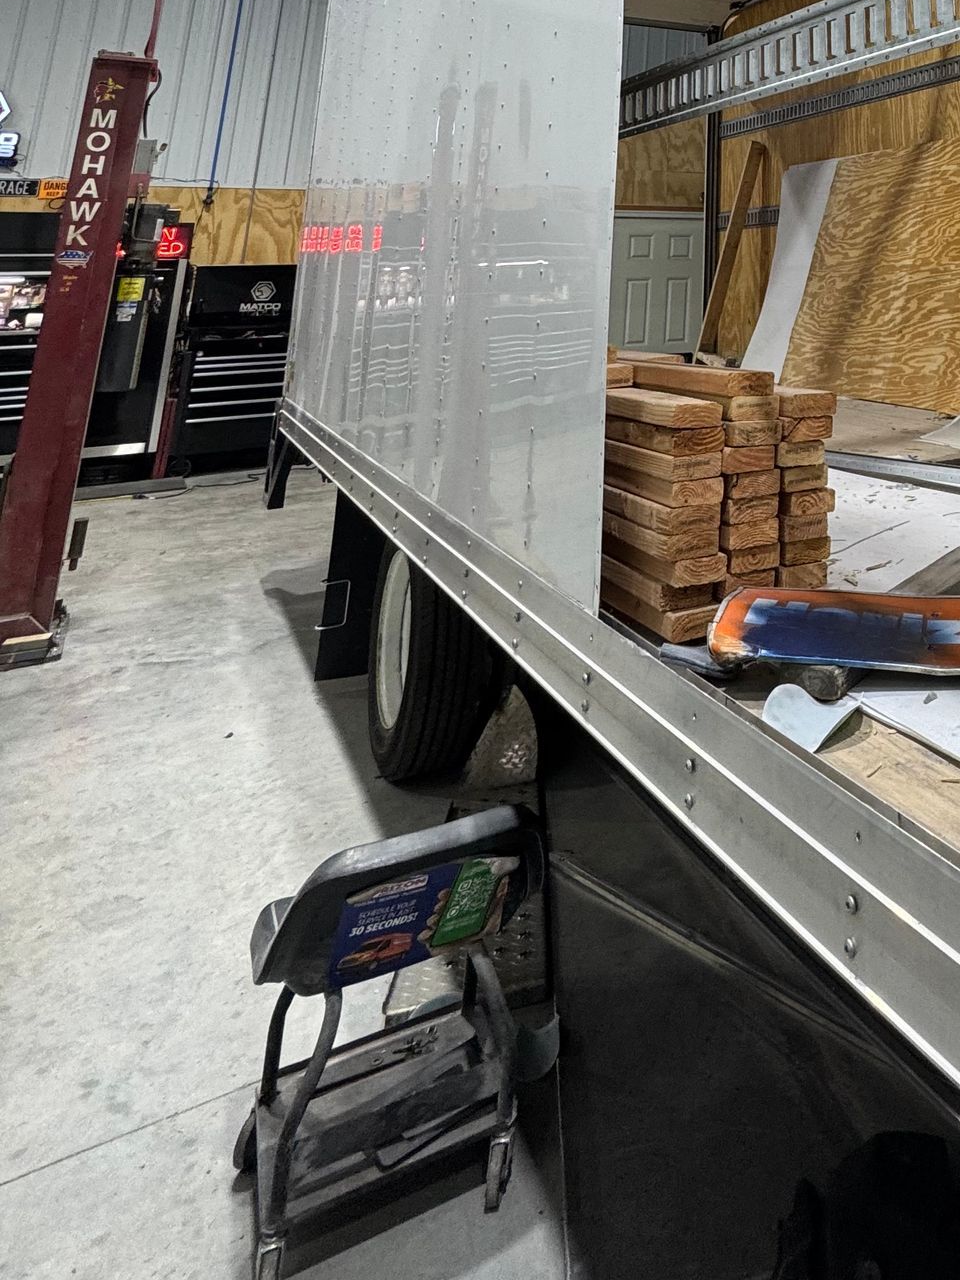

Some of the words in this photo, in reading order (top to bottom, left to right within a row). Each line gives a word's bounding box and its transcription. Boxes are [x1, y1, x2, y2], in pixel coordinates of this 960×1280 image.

[66, 108, 118, 246] MOHAWK
[239, 302, 282, 313] MATCO
[349, 925, 365, 937] 30
[364, 912, 419, 933] SECONDS!
